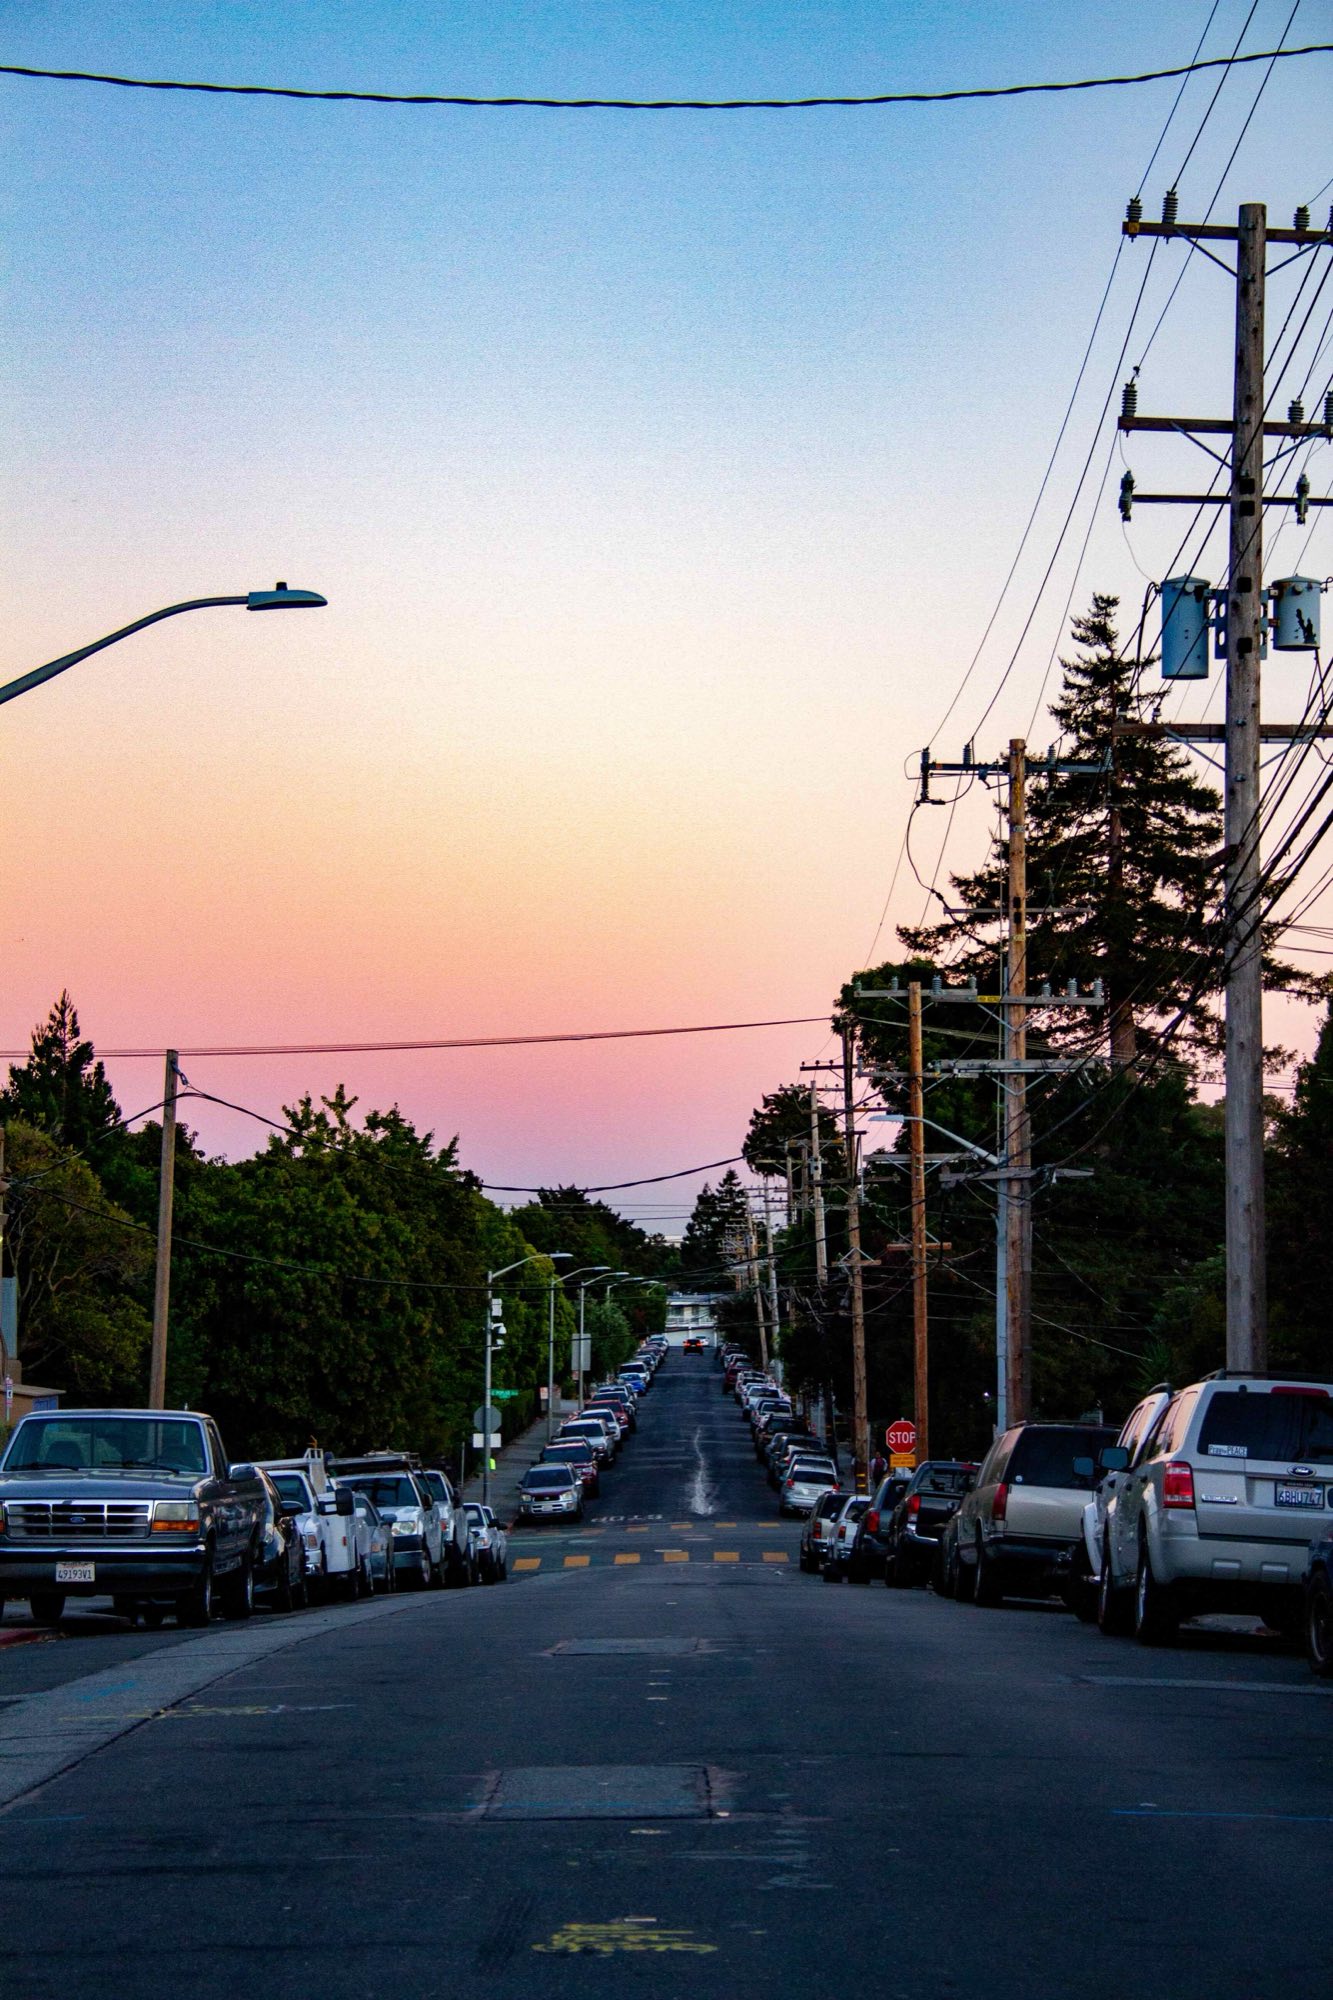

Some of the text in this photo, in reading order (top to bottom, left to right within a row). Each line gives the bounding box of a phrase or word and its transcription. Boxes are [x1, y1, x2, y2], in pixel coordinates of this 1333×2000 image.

[889, 1431, 916, 1444] STOP
[1227, 1445, 1248, 1458] PEACE
[1279, 1489, 1322, 1505] 6BHU747
[58, 1569, 92, 1579] 49193V1
